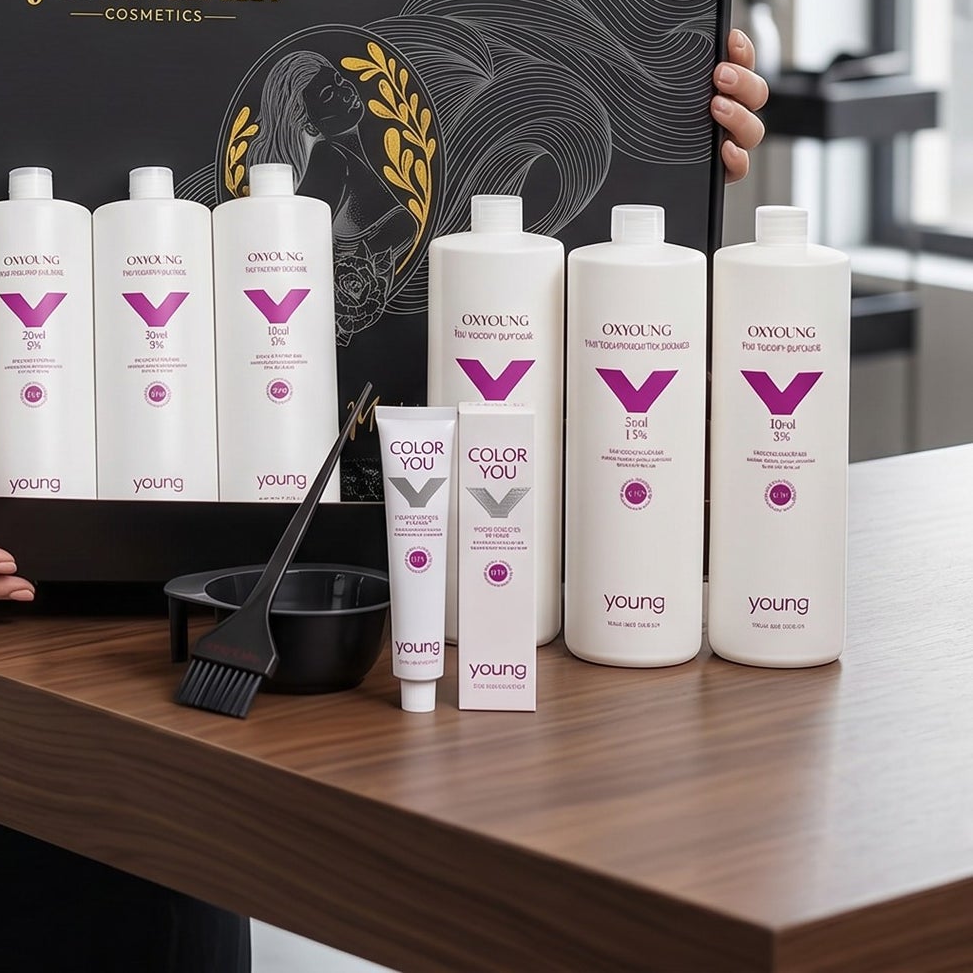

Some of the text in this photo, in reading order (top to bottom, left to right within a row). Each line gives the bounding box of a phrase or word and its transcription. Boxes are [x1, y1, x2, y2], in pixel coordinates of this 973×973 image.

[104, 8, 202, 22] COSMETICS
[3, 255, 60, 266] OXYOUNG
[247, 251, 304, 262] OXYOUNG
[462, 314, 529, 327] OXYOUNG
[602, 323, 672, 337] OXYOUNG
[747, 325, 816, 339] OXYOUNG
[773, 431, 791, 442] 3%
[390, 440, 445, 455] COLOR
[468, 447, 528, 463] COLOR
[400, 456, 434, 471] YOU
[479, 464, 517, 480] YOU
[9, 477, 61, 494] young
[133, 477, 184, 494] young
[257, 474, 307, 490] young
[604, 594, 666, 615] young
[748, 596, 810, 616] young
[395, 640, 441, 656] young
[469, 663, 527, 680] young
